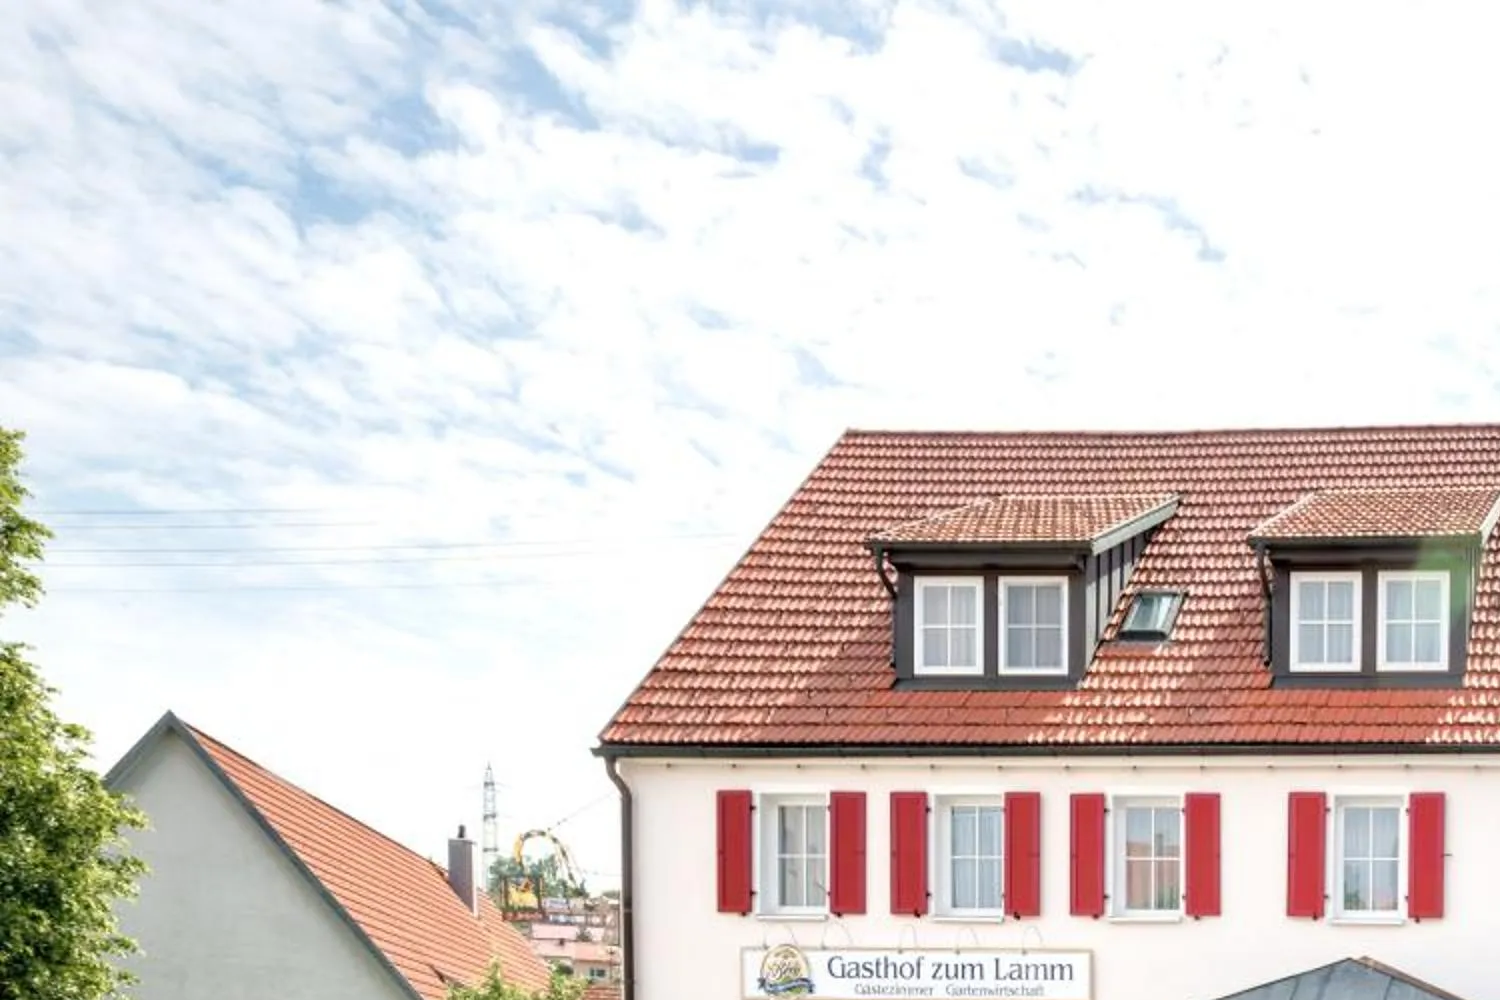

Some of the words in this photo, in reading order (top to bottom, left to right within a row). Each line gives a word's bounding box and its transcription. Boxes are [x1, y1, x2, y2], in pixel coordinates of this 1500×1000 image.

[827, 955, 925, 980] Gasthof
[931, 961, 985, 981] zum
[994, 958, 1074, 981] Lamm
